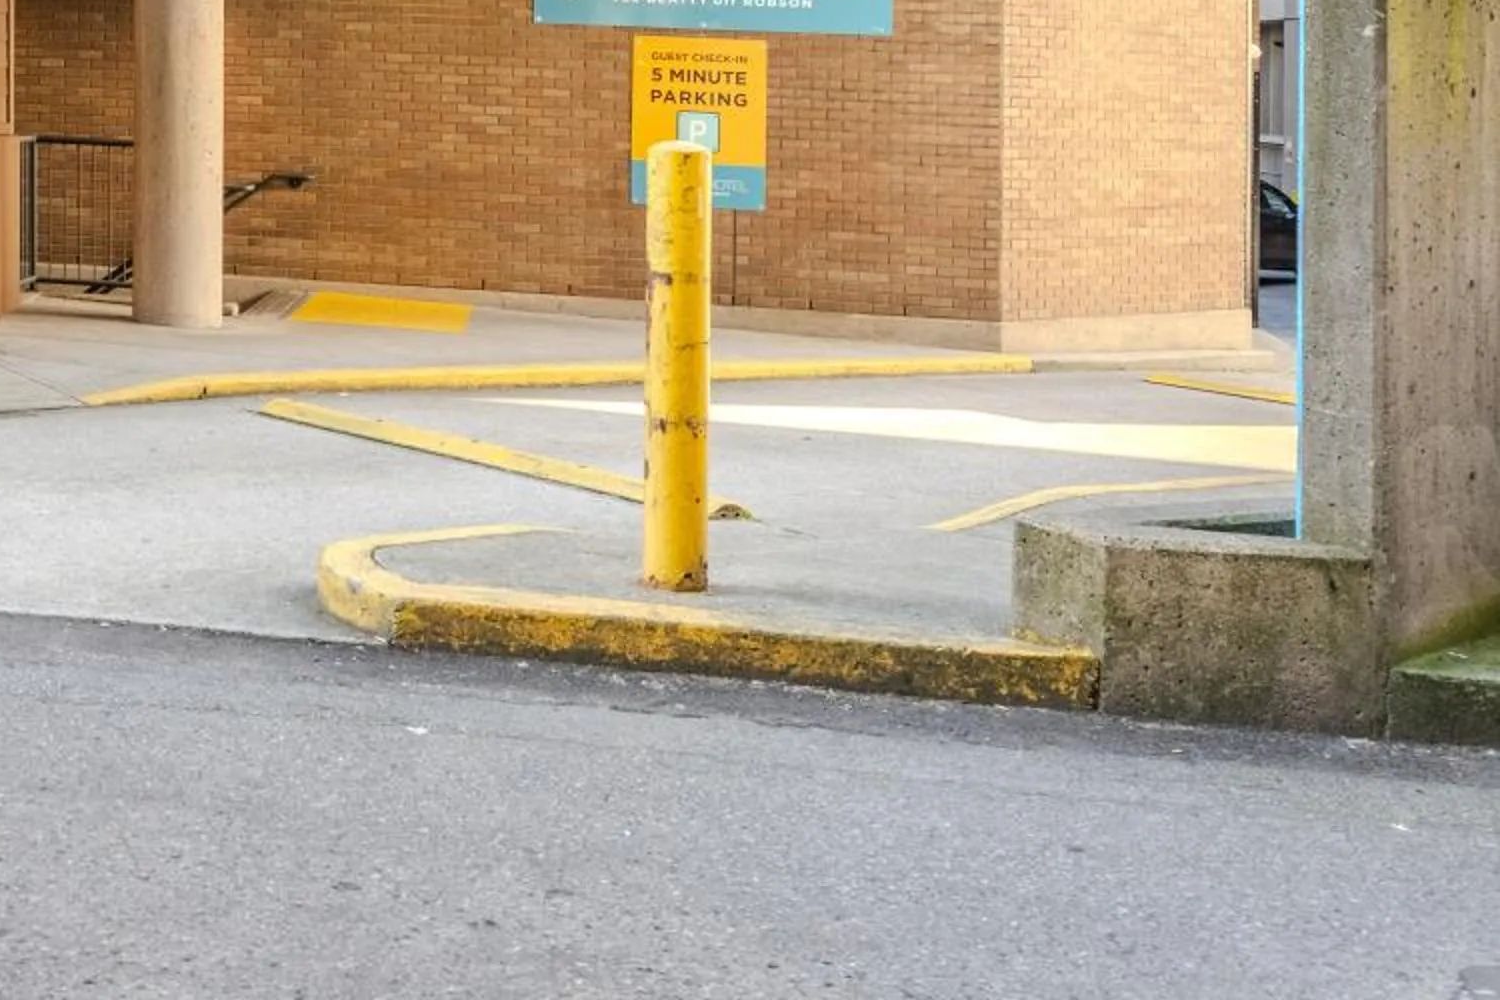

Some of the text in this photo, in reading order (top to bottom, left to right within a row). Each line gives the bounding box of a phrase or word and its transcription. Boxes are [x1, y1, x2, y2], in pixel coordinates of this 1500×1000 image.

[651, 51, 749, 64] GUEST CHECK-IN
[651, 67, 748, 86] 5 MINUTE
[650, 89, 748, 108] PARKING
[689, 119, 707, 142] P
